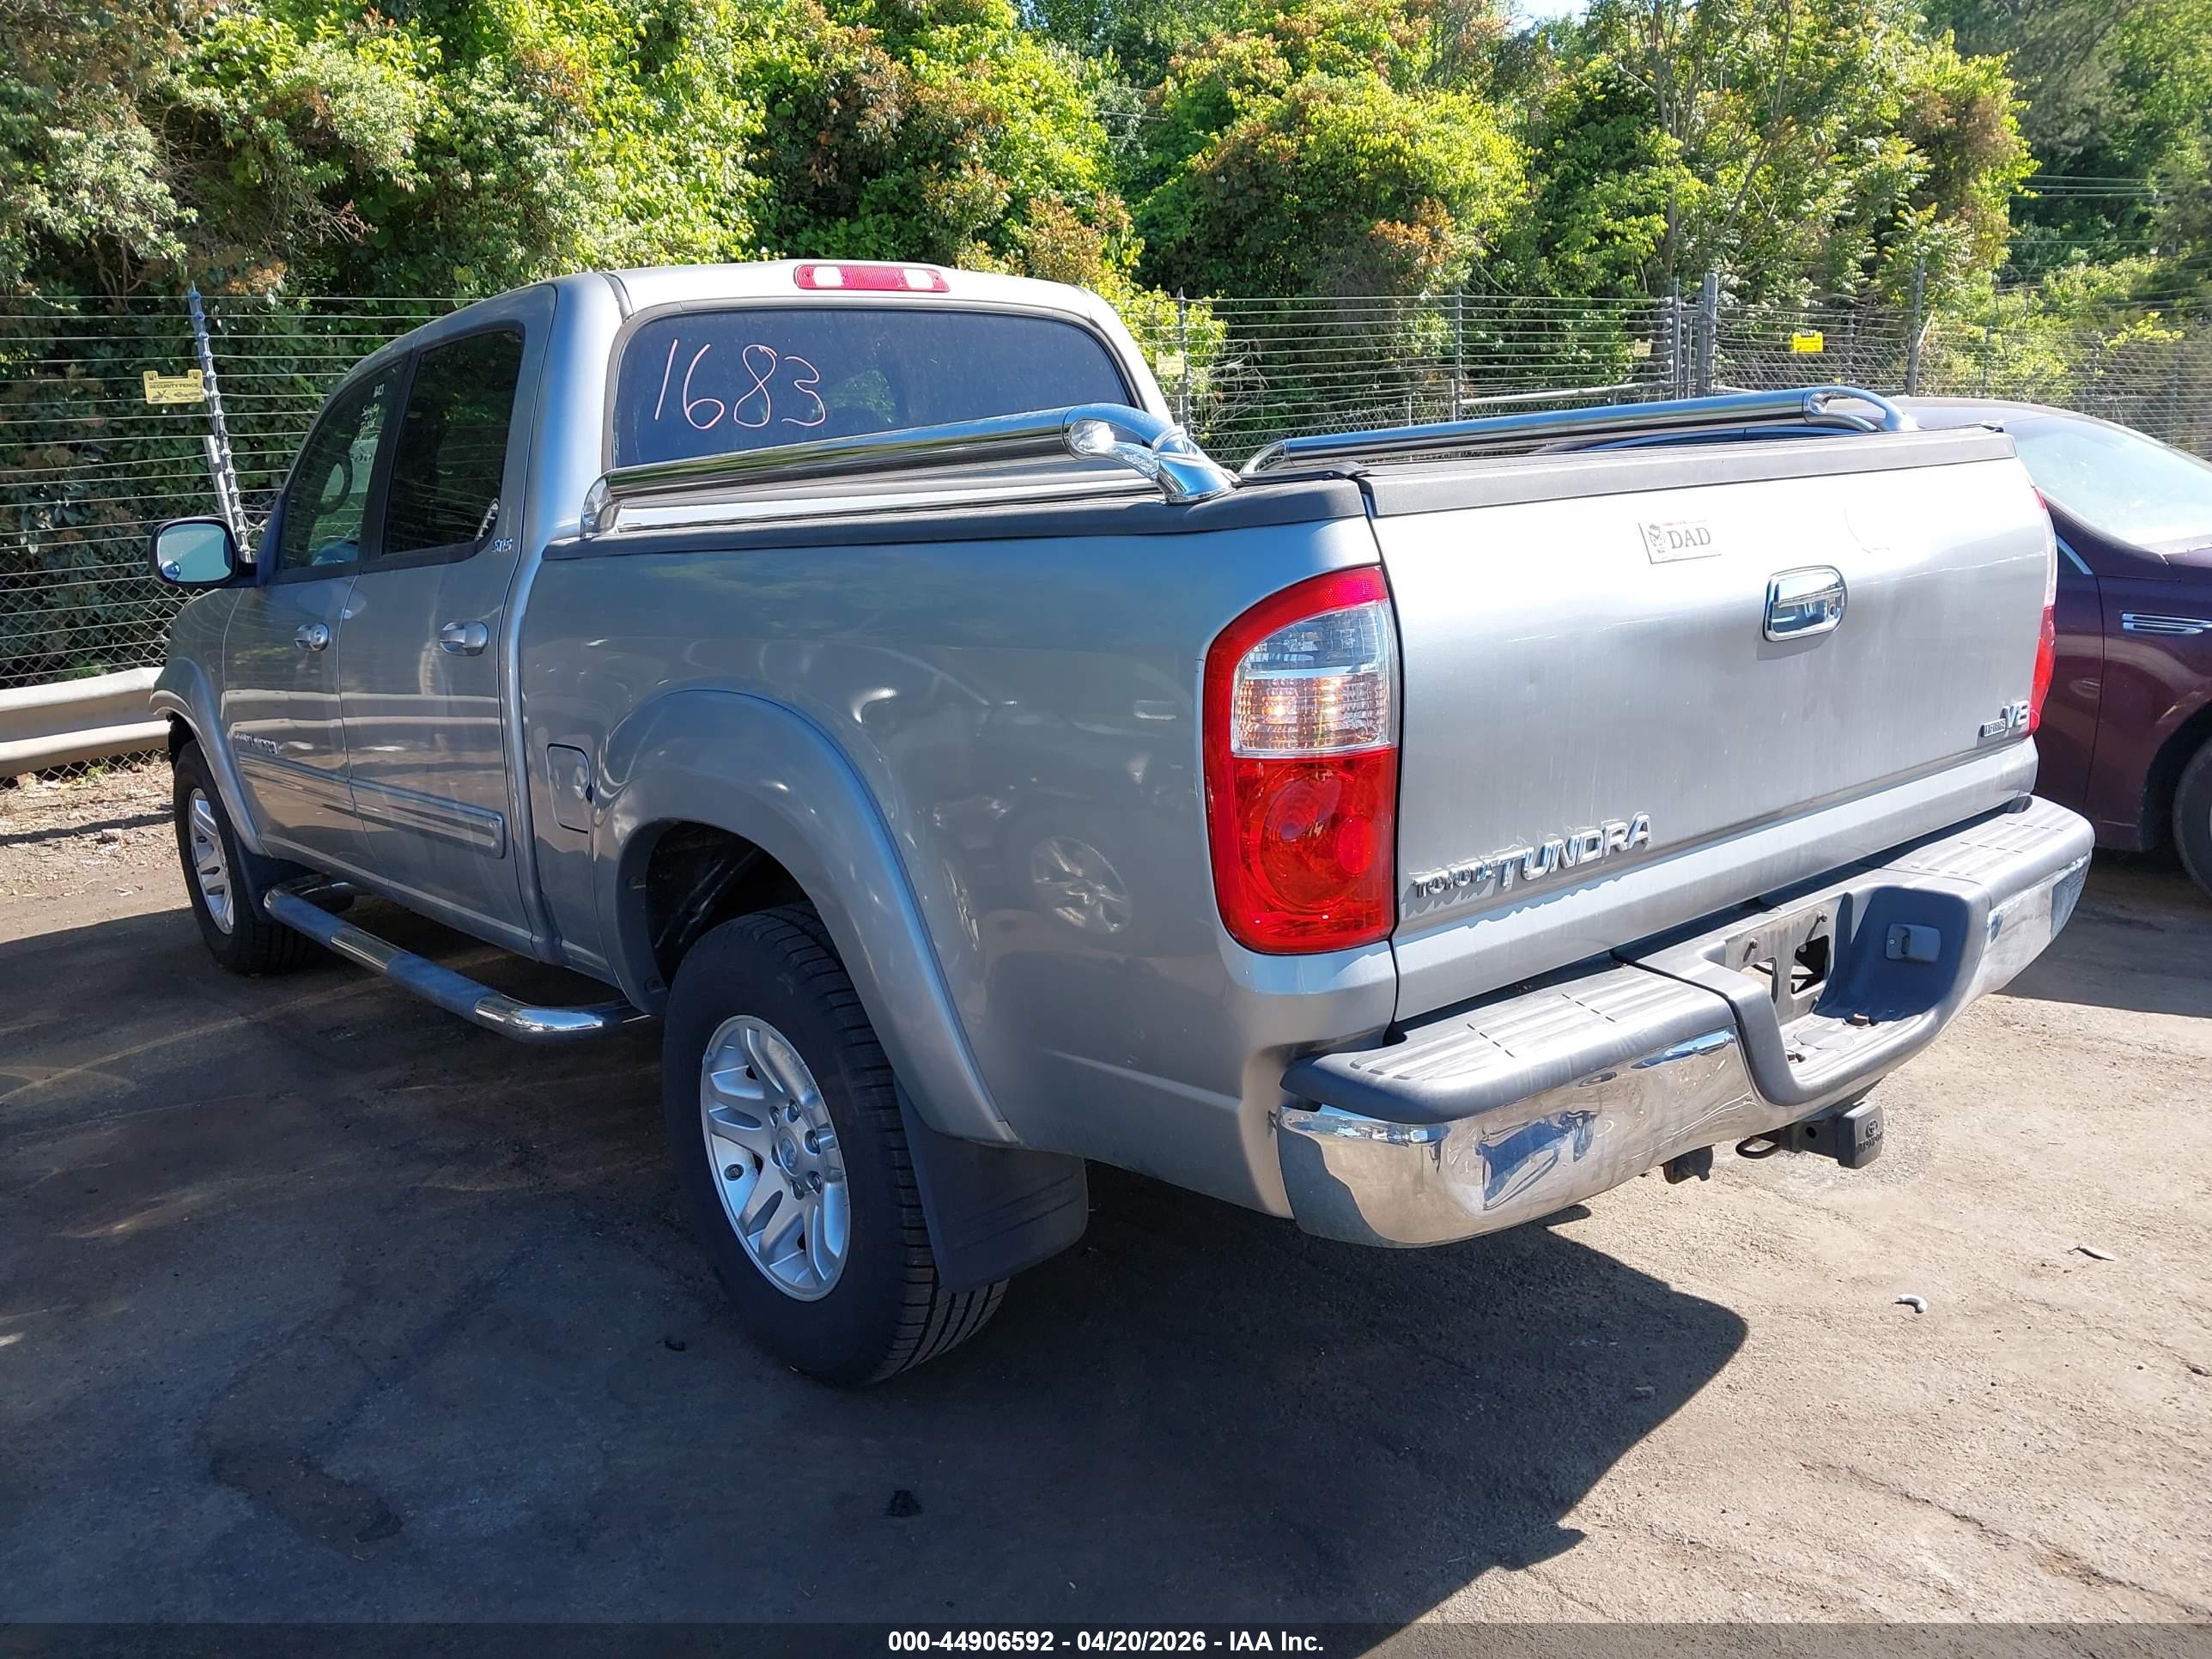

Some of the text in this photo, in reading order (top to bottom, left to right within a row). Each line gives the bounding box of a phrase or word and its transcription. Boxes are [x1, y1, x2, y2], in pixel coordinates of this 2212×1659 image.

[654, 338, 826, 429] 1683
[1667, 527, 1711, 550] DAD
[1411, 812, 1652, 898] TOYOTA TUNDRA
